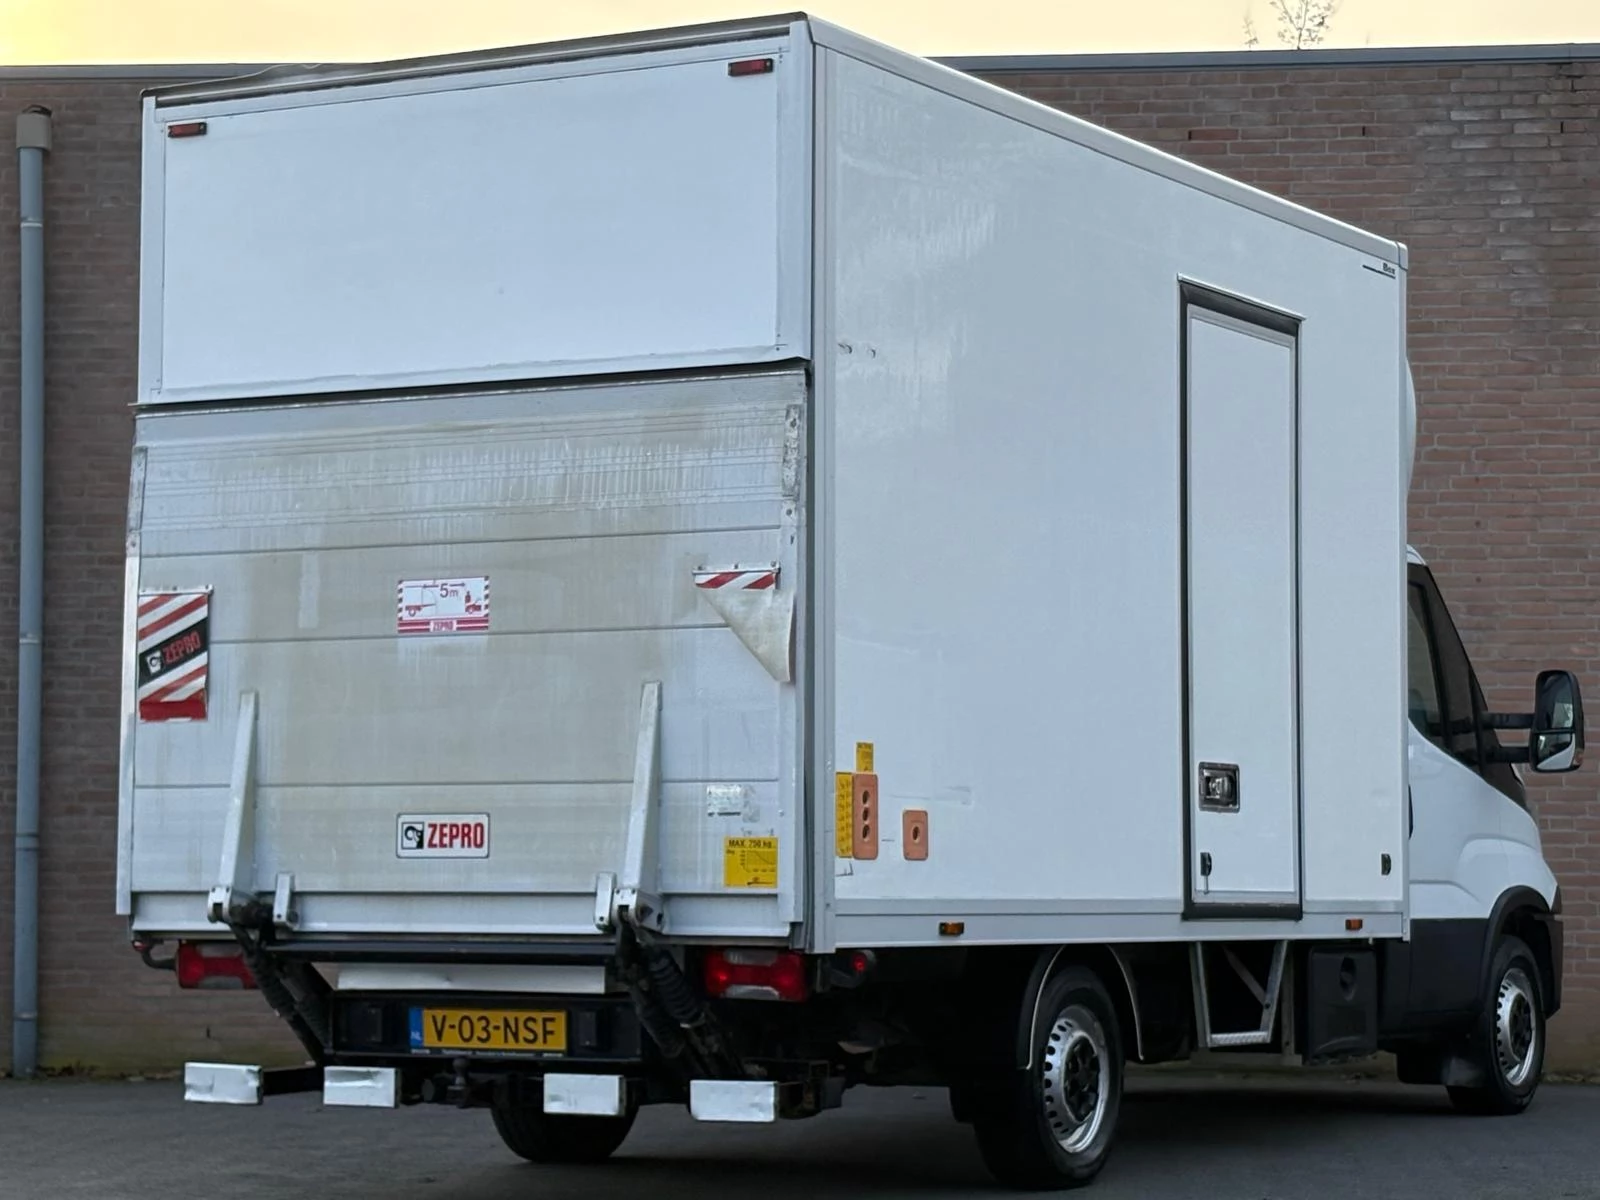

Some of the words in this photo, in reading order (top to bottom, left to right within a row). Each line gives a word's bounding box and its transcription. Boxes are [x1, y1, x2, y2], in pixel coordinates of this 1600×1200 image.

[162, 631, 201, 665] ZEPRO
[427, 823, 485, 849] ZEPRO
[431, 1014, 557, 1045] V-03-NSF
